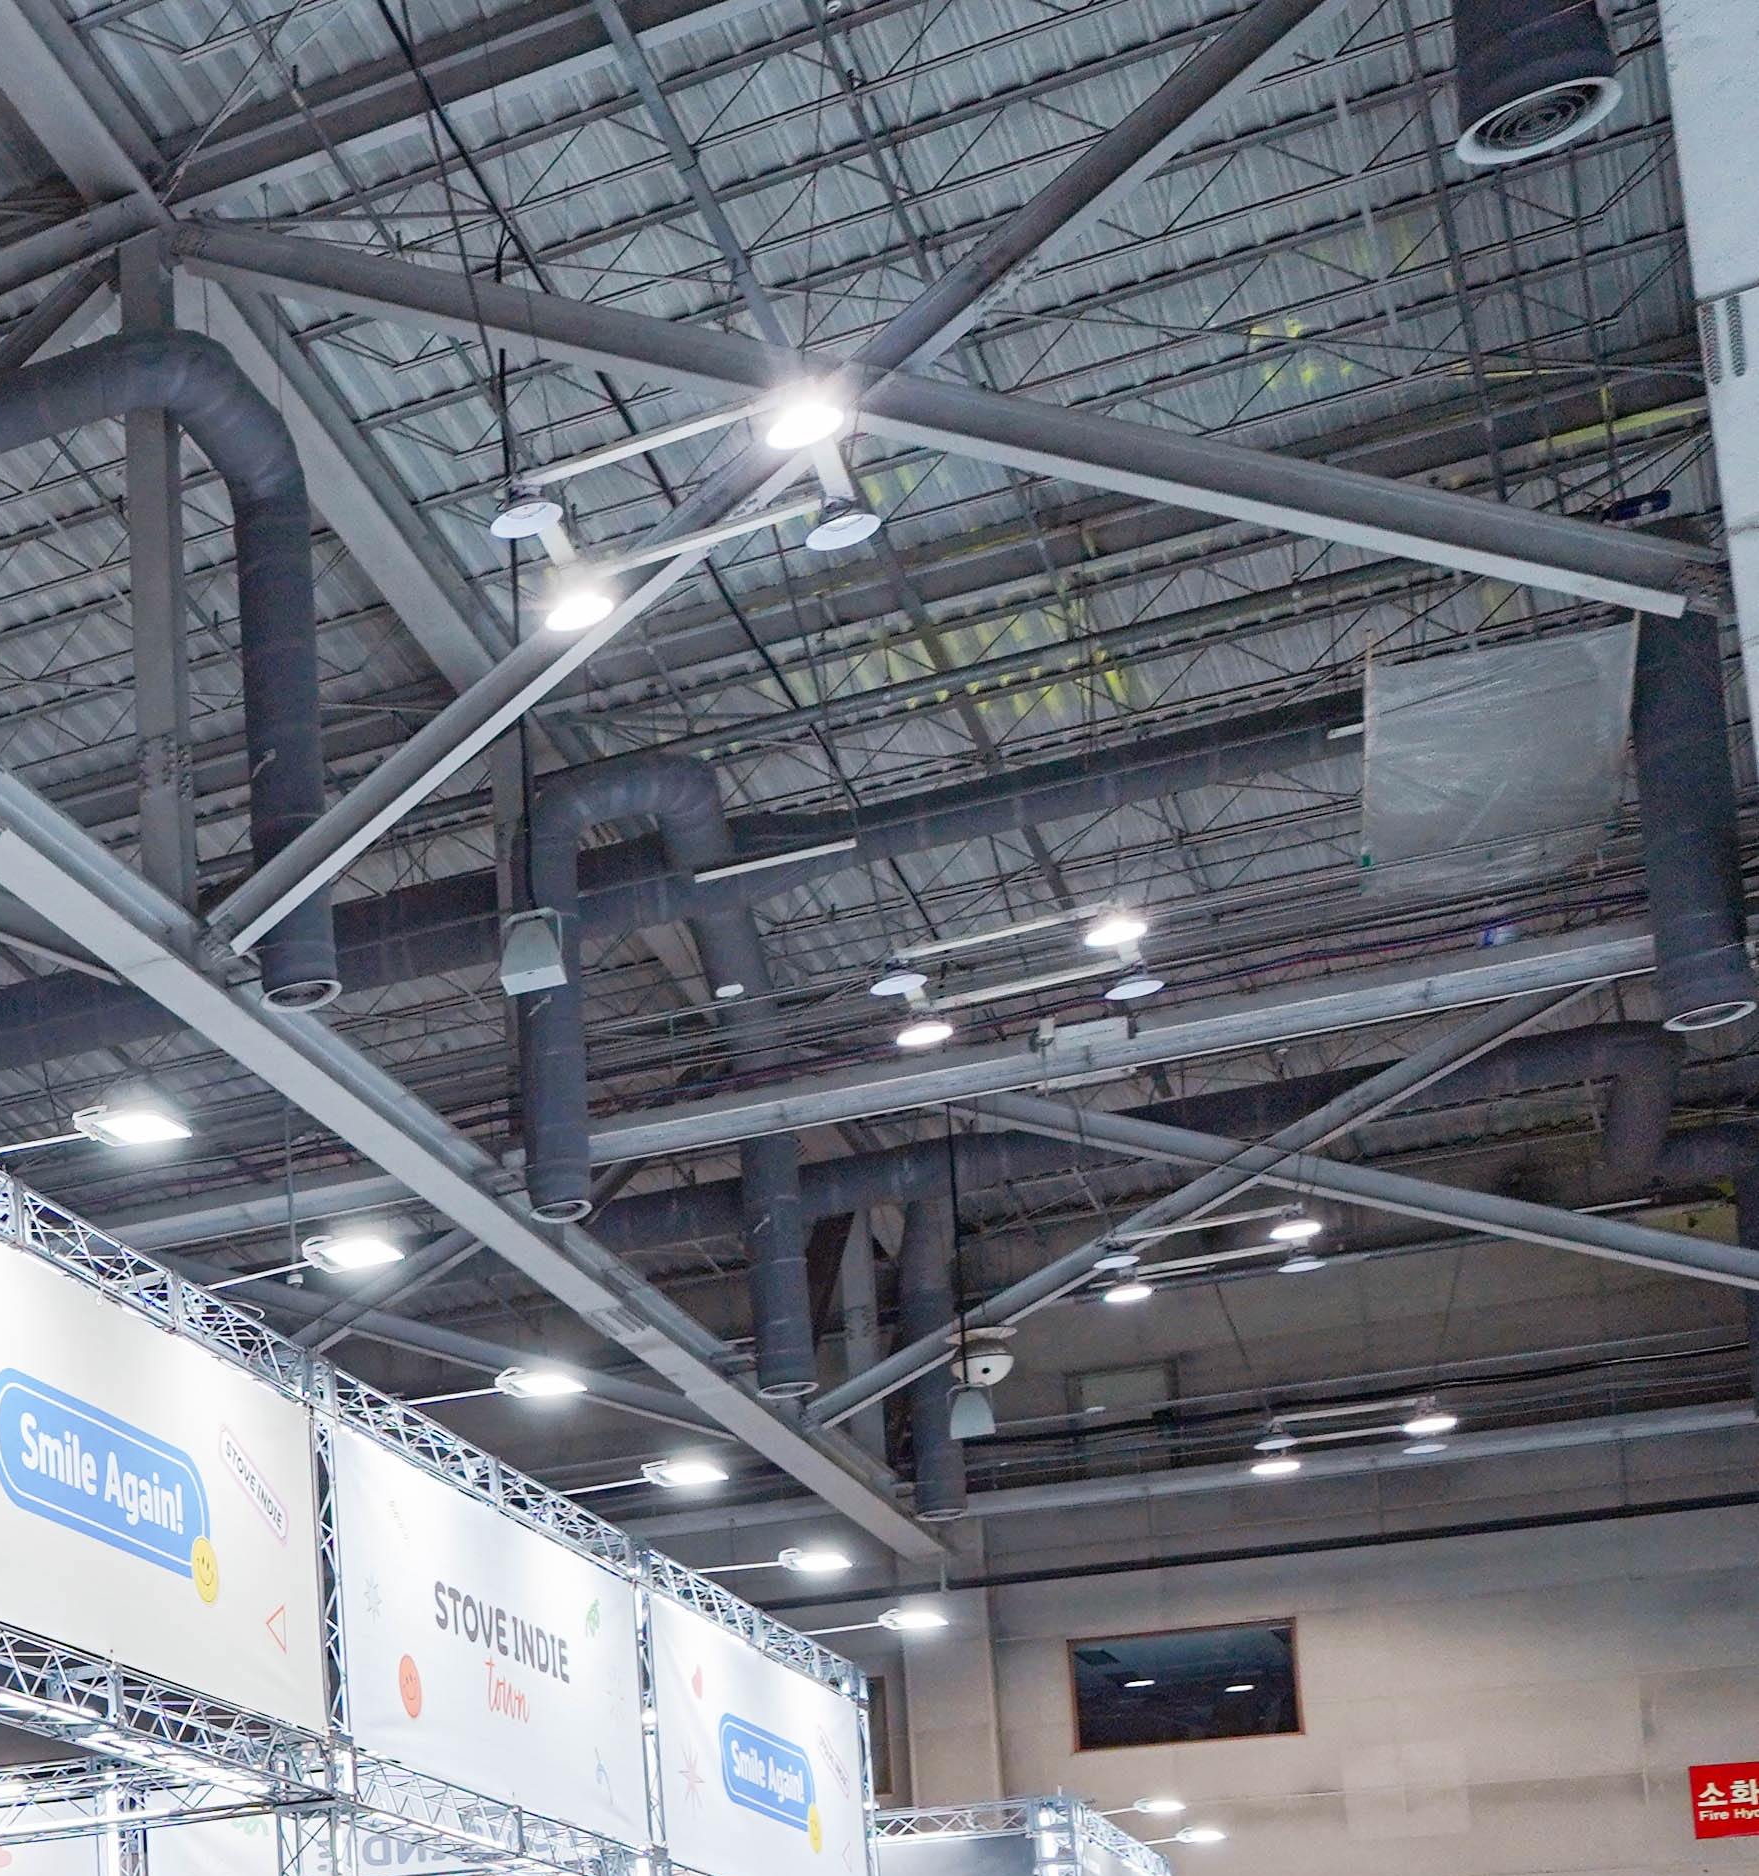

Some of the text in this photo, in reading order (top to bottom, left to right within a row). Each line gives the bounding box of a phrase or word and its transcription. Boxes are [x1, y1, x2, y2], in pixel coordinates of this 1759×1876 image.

[20, 1412, 184, 1536] Smile Again!
[225, 1440, 284, 1530] STOVE INDIE
[434, 1581, 570, 1684] STOVE INDIE
[485, 1659, 531, 1724] town
[731, 1740, 766, 1789] Smile
[767, 1755, 804, 1803] Again!
[1699, 1810, 1729, 1821] Fire
